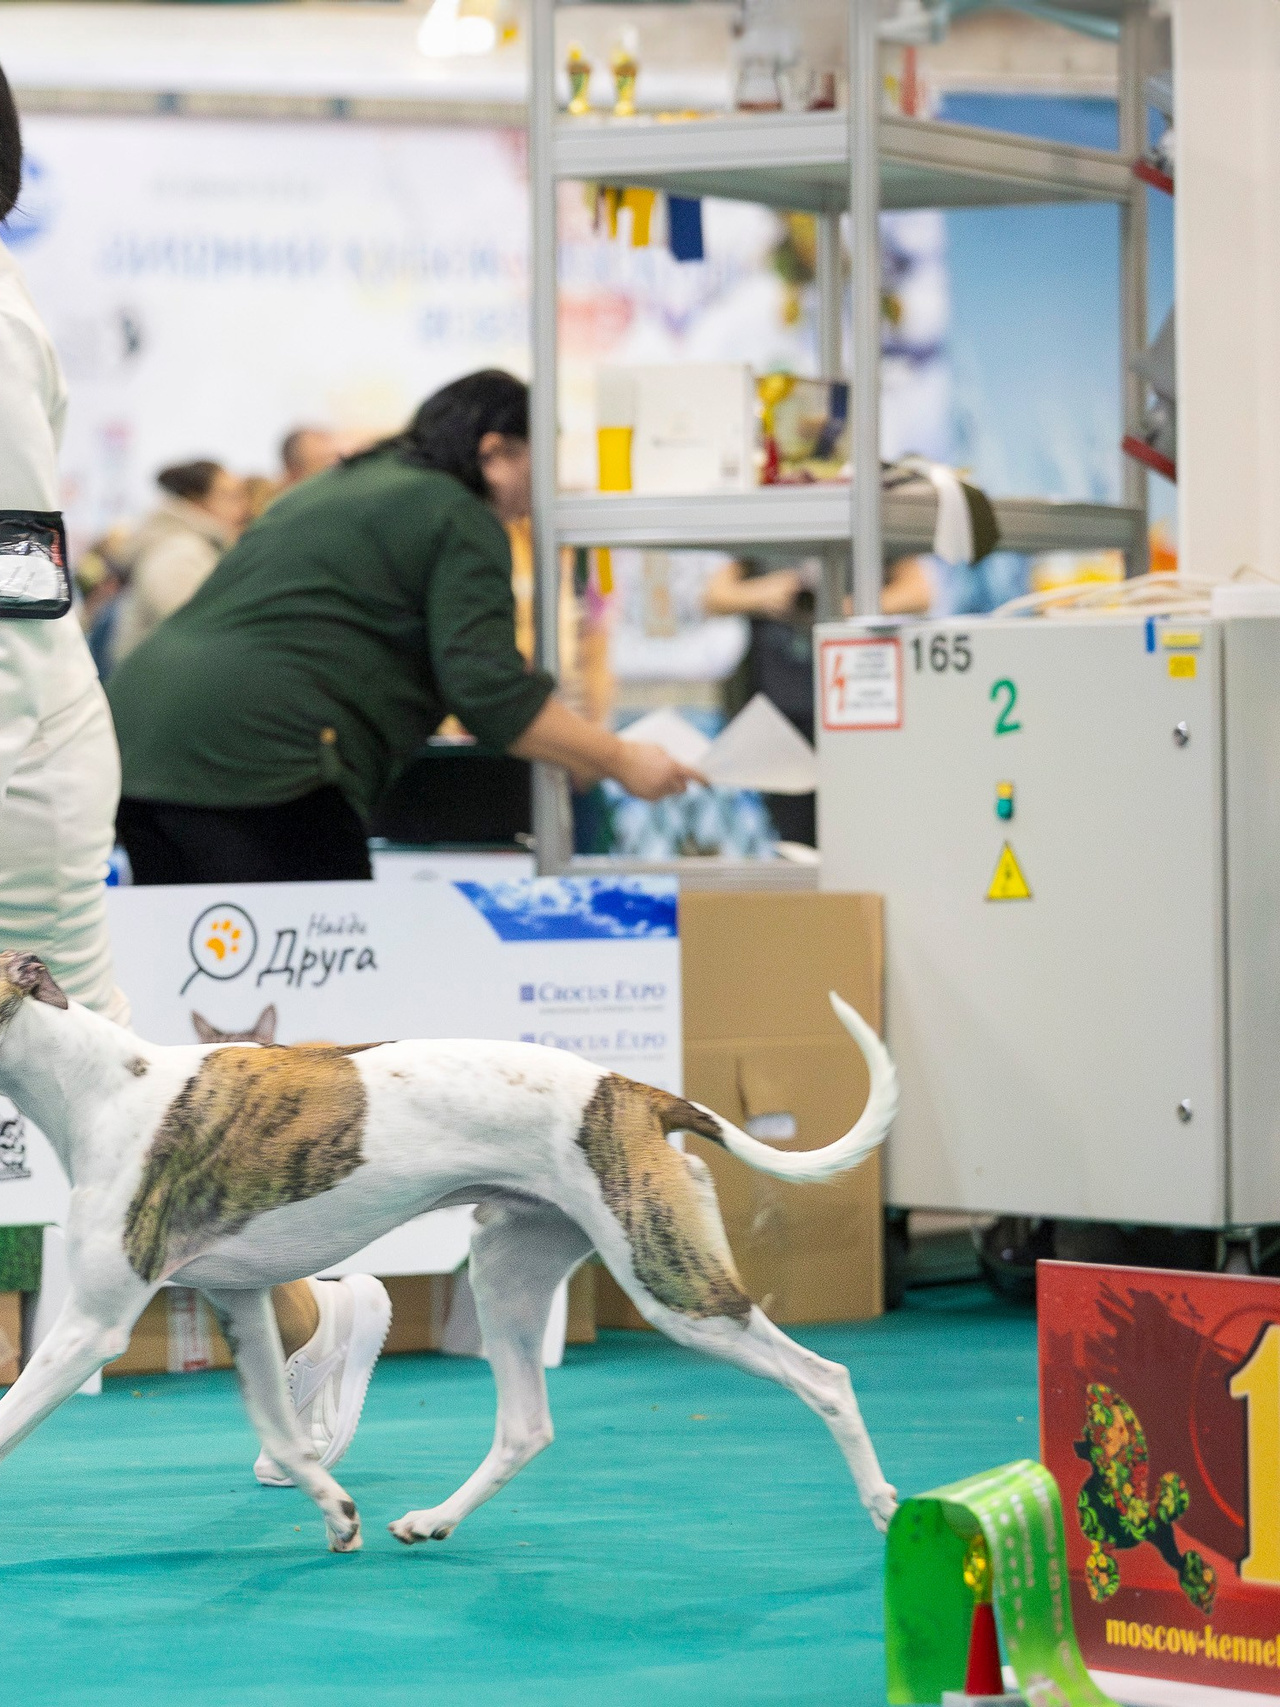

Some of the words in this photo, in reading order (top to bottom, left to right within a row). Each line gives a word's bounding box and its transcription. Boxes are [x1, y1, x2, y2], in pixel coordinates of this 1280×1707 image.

[911, 633, 972, 673] 165
[989, 677, 1021, 736] 2
[256, 928, 377, 988] Друга
